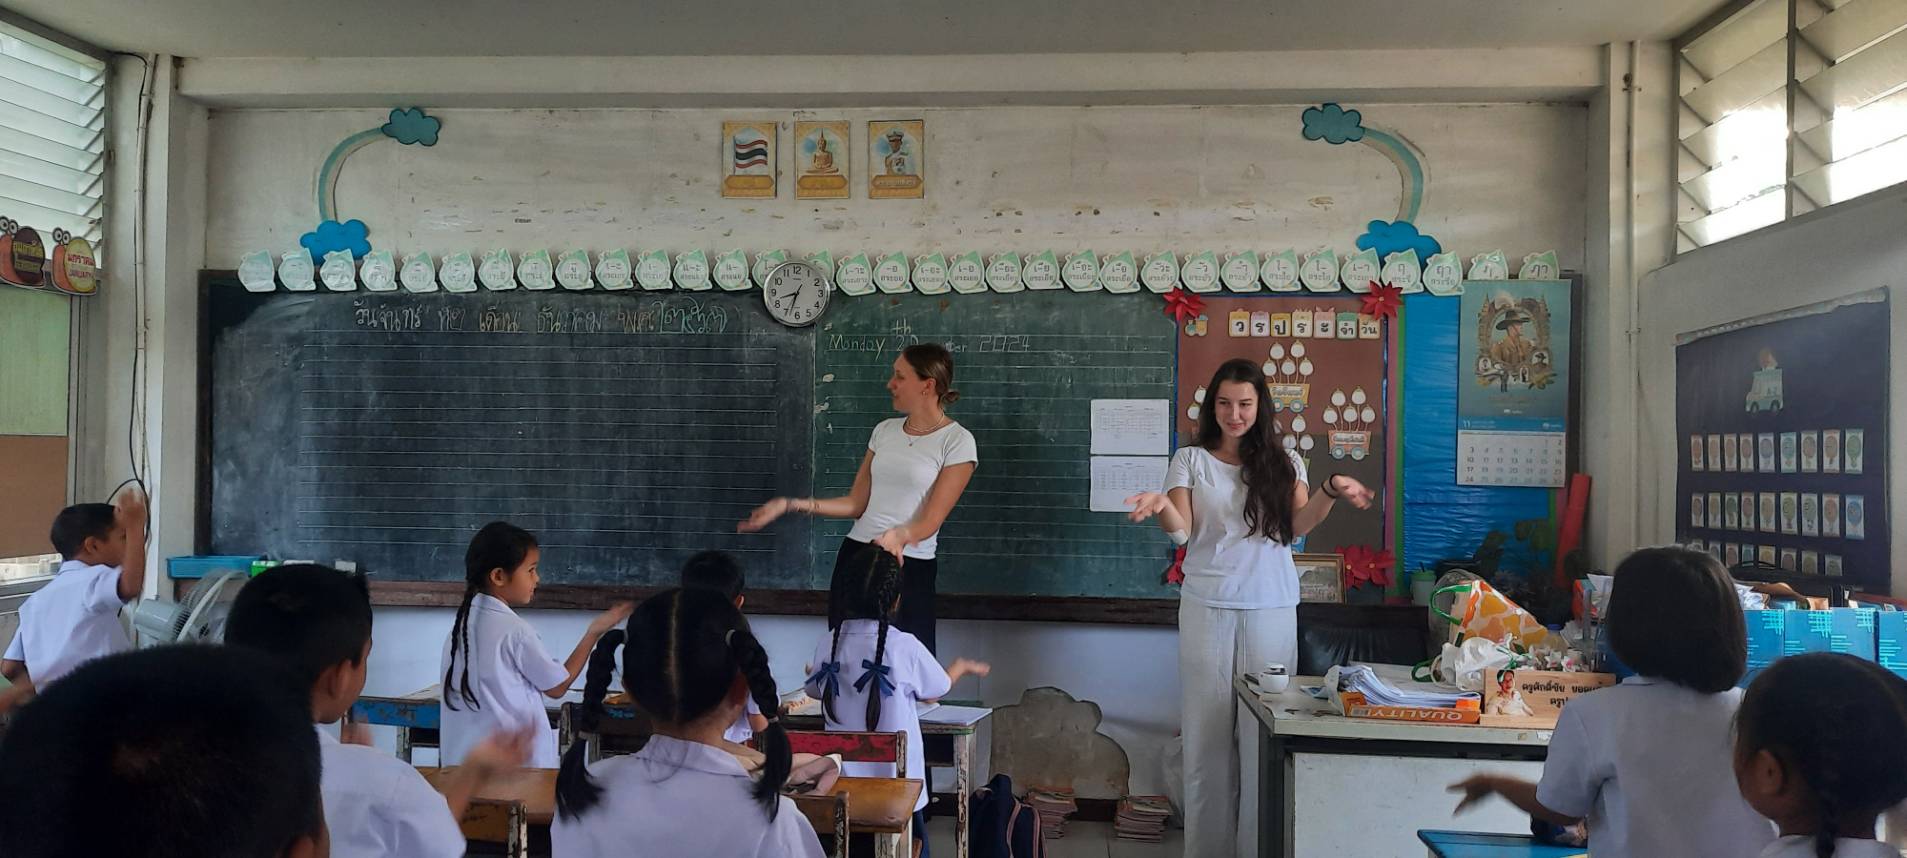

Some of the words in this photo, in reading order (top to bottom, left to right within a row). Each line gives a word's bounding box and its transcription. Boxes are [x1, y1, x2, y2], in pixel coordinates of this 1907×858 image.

[783, 269, 790, 277] 11
[793, 266, 802, 275] 12
[807, 269, 810, 278] 1
[775, 277, 783, 286] 10
[814, 278, 820, 287] 2
[771, 289, 777, 297] 9
[818, 290, 824, 298] 3
[775, 300, 781, 309] 8
[814, 301, 820, 309] 4
[783, 308, 790, 317] 7
[795, 312, 801, 320] 6
[806, 309, 812, 317] 5
[828, 334, 886, 362] Monday
[979, 334, 1031, 353] 2024
[1373, 708, 1463, 721] QUALITY
